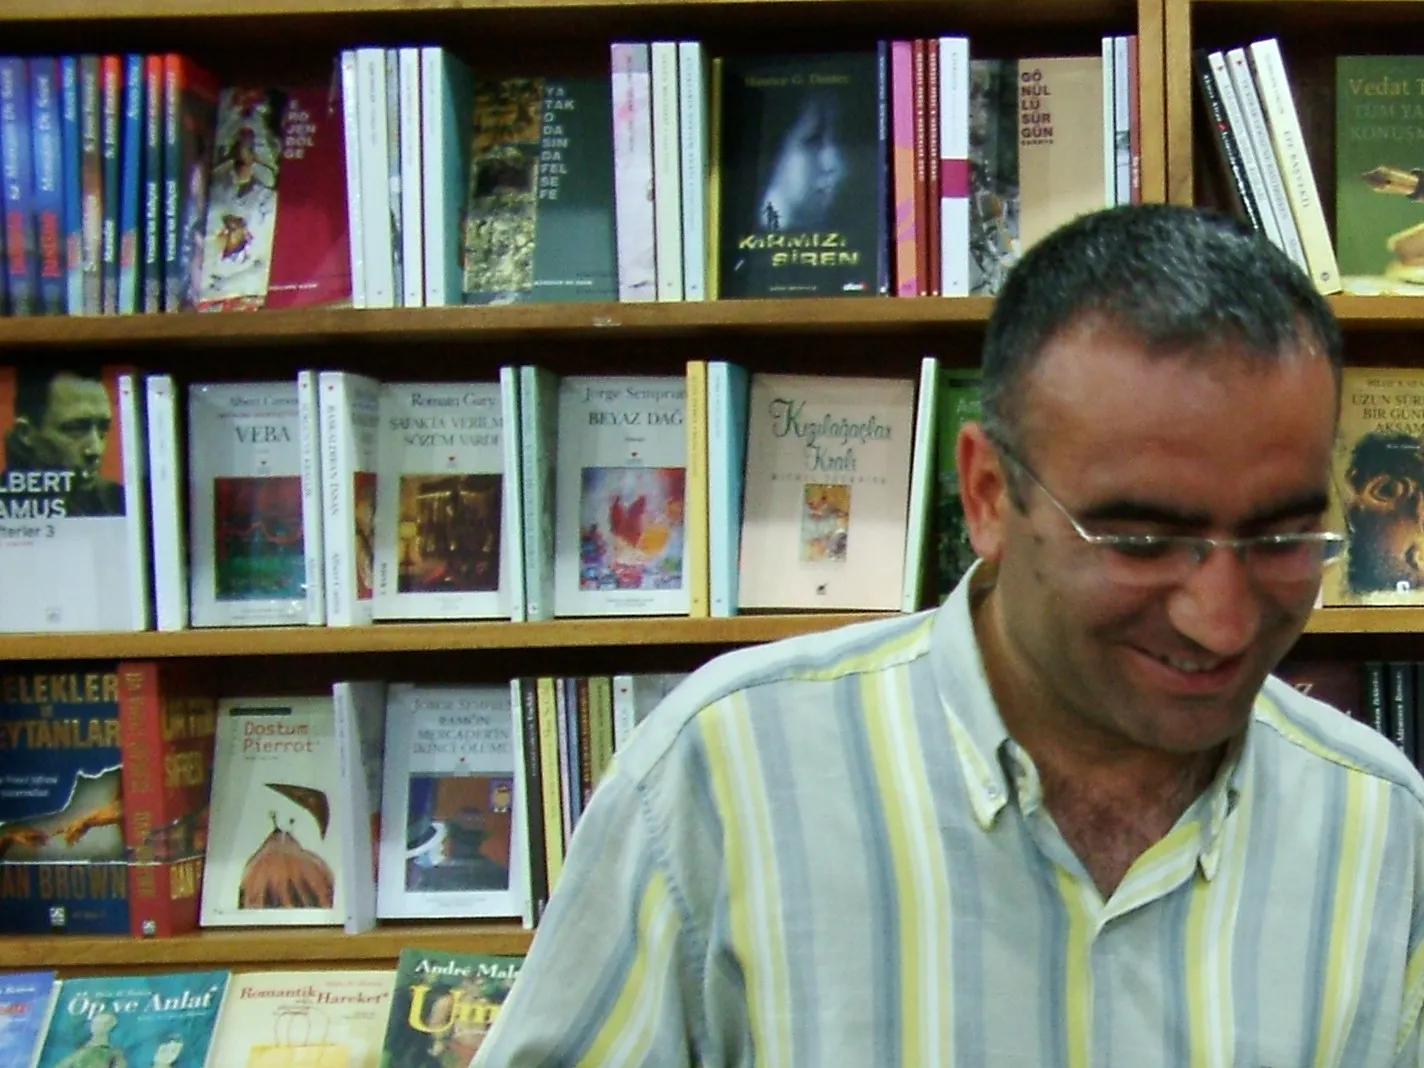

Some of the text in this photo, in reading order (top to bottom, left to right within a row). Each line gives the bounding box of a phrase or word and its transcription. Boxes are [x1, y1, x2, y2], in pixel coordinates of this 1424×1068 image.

[1021, 68, 1042, 82] GÖ
[1349, 75, 1411, 96] Vedat
[544, 100, 575, 110] TAK
[543, 112, 555, 122] O
[542, 125, 563, 135] DA
[541, 151, 561, 161] DA
[540, 163, 568, 174] FEL
[539, 176, 559, 186] SE
[538, 188, 557, 199] FE
[772, 250, 860, 267] SİREN
[584, 387, 618, 402] Jorge
[1352, 395, 1391, 406] UZUN
[588, 409, 684, 426] BEYAZ DAĞ
[1362, 407, 1388, 419] BİR
[771, 397, 893, 448] Kızılağaçlar
[235, 425, 291, 443] VEBA
[0, 471, 73, 493] LBERT
[0, 498, 67, 519] AMUS
[45, 523, 55, 538] 3
[0, 672, 118, 702] ELEKLER
[0, 719, 120, 748] EYTANLAR
[243, 721, 309, 737] Dostum
[243, 737, 314, 753] Pierrot
[40, 865, 126, 899] BROWN
[240, 984, 317, 1002] Romantik
[67, 990, 106, 1018] Öp
[113, 997, 139, 1014] ve
